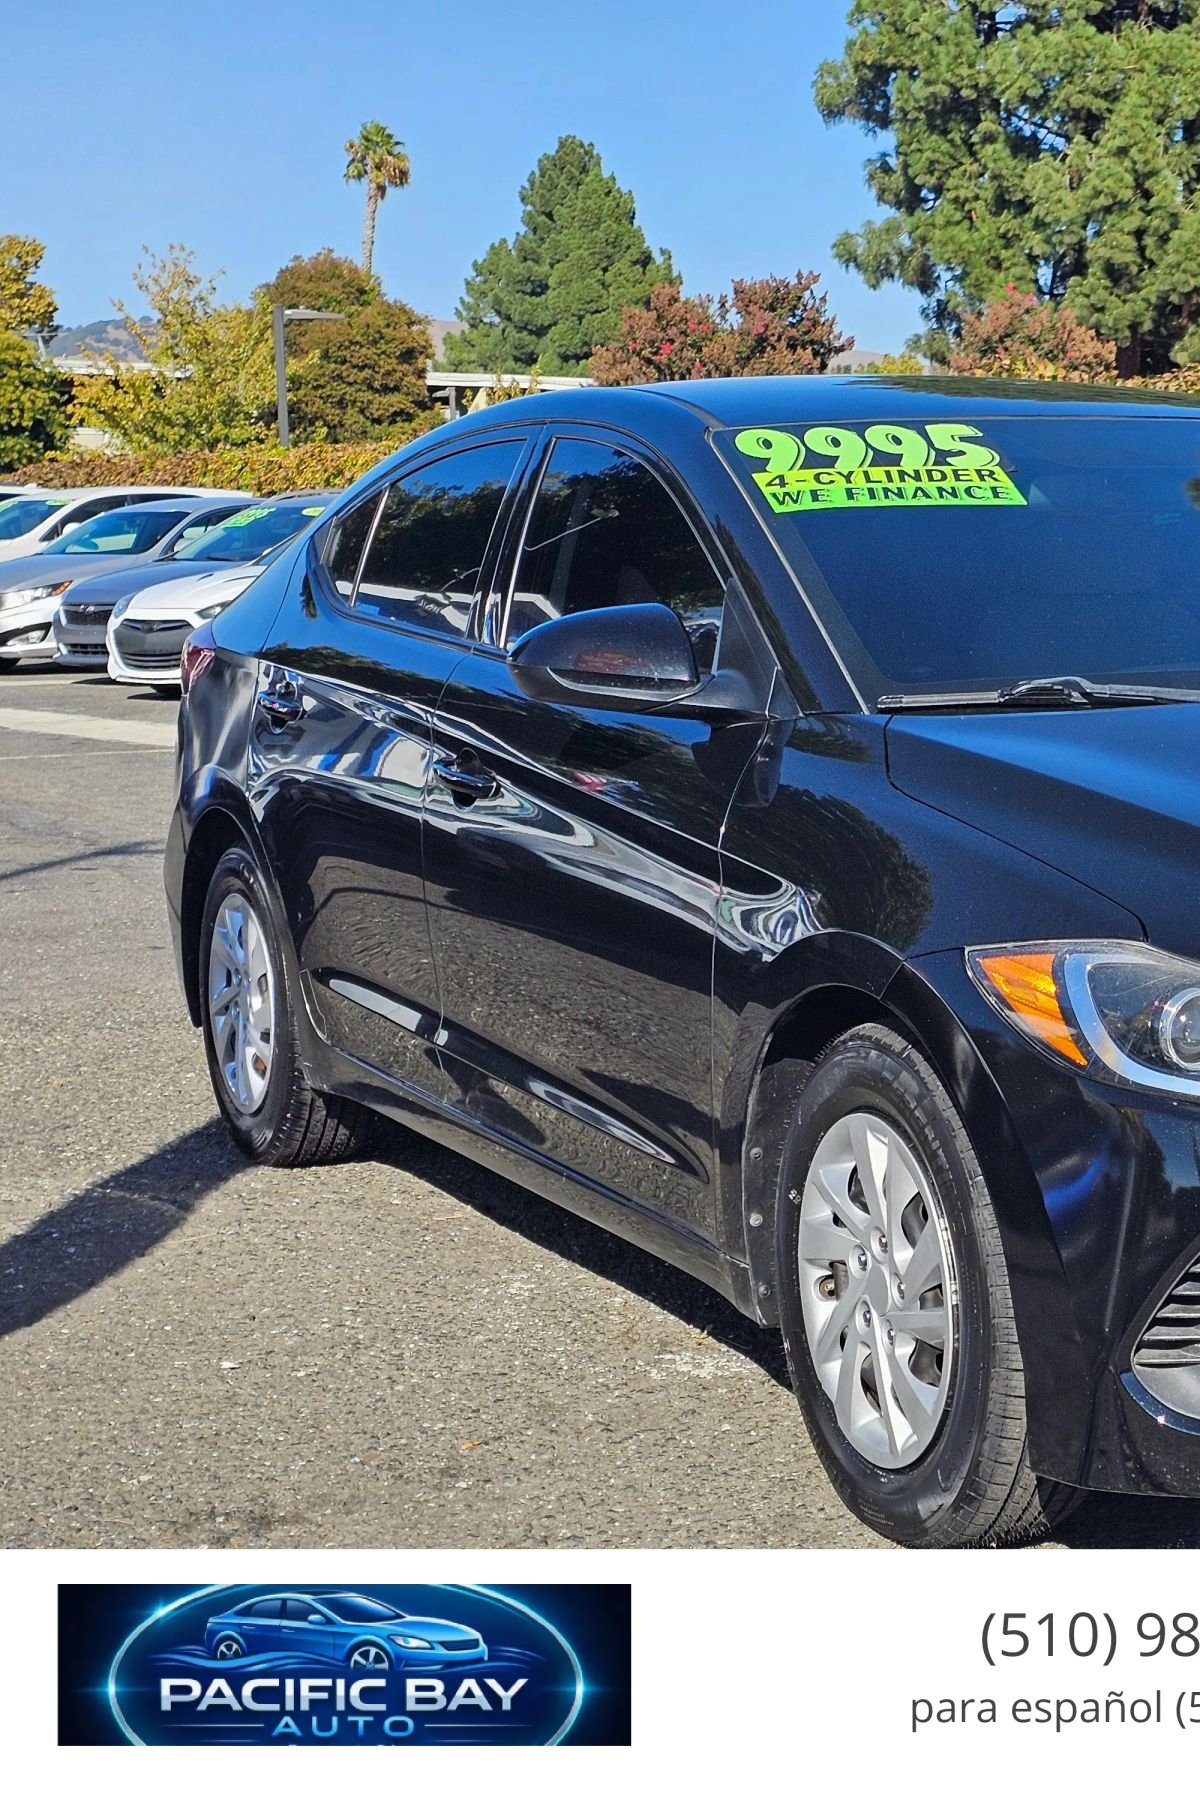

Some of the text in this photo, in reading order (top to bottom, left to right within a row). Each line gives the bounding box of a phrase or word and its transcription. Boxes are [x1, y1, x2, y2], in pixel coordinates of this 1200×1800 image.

[734, 423, 1001, 472] 9995
[765, 468, 998, 489] 4-CYLINDER
[770, 485, 1013, 506] WE FINANCE
